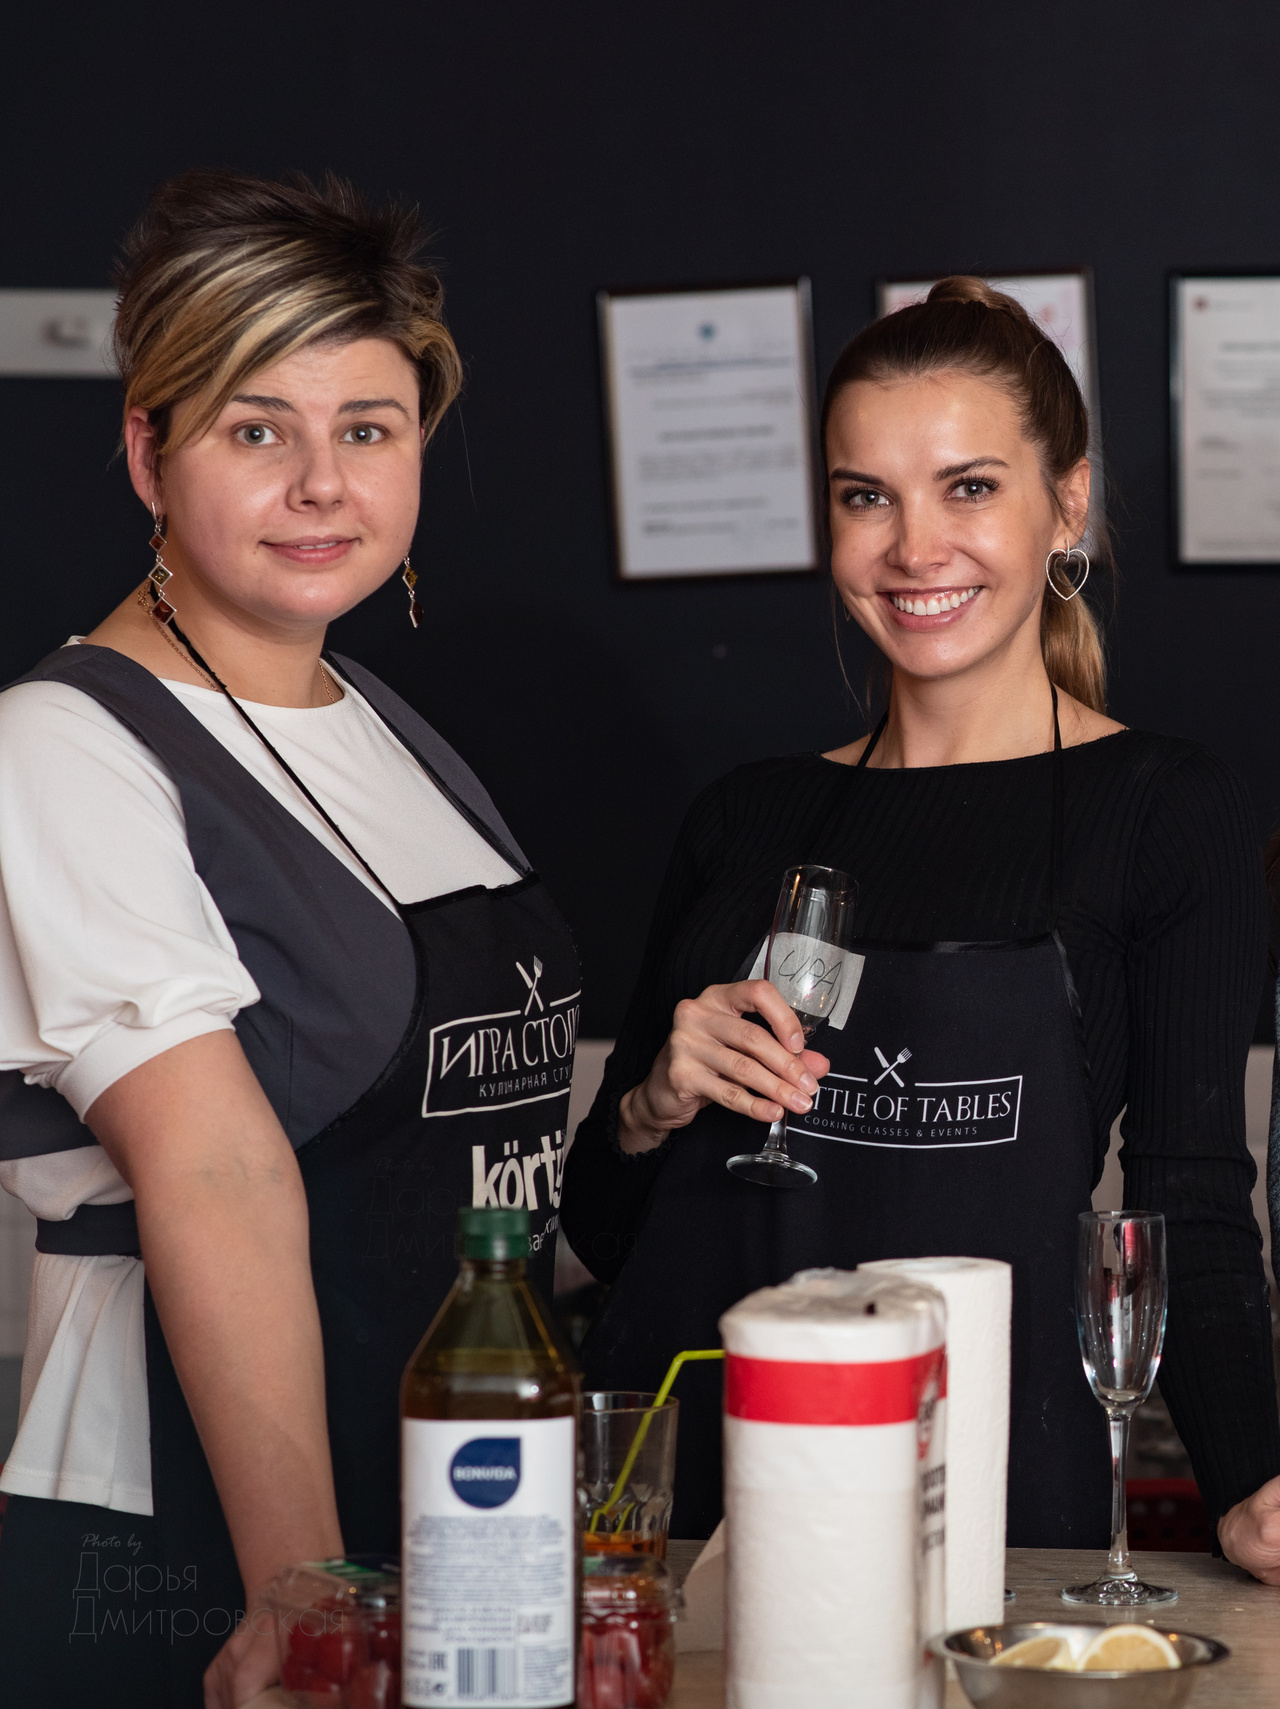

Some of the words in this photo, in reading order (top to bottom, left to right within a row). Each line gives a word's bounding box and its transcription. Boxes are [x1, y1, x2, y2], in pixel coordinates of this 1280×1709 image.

[440, 1027, 518, 1080] ИГРА
[813, 1086, 867, 1119] TTLE
[873, 1095, 909, 1122] OF
[917, 1091, 1013, 1123] TABLES
[804, 1115, 855, 1132] COOKING
[860, 1125, 910, 1138] CLASSES
[931, 1127, 978, 1138] EVENTS
